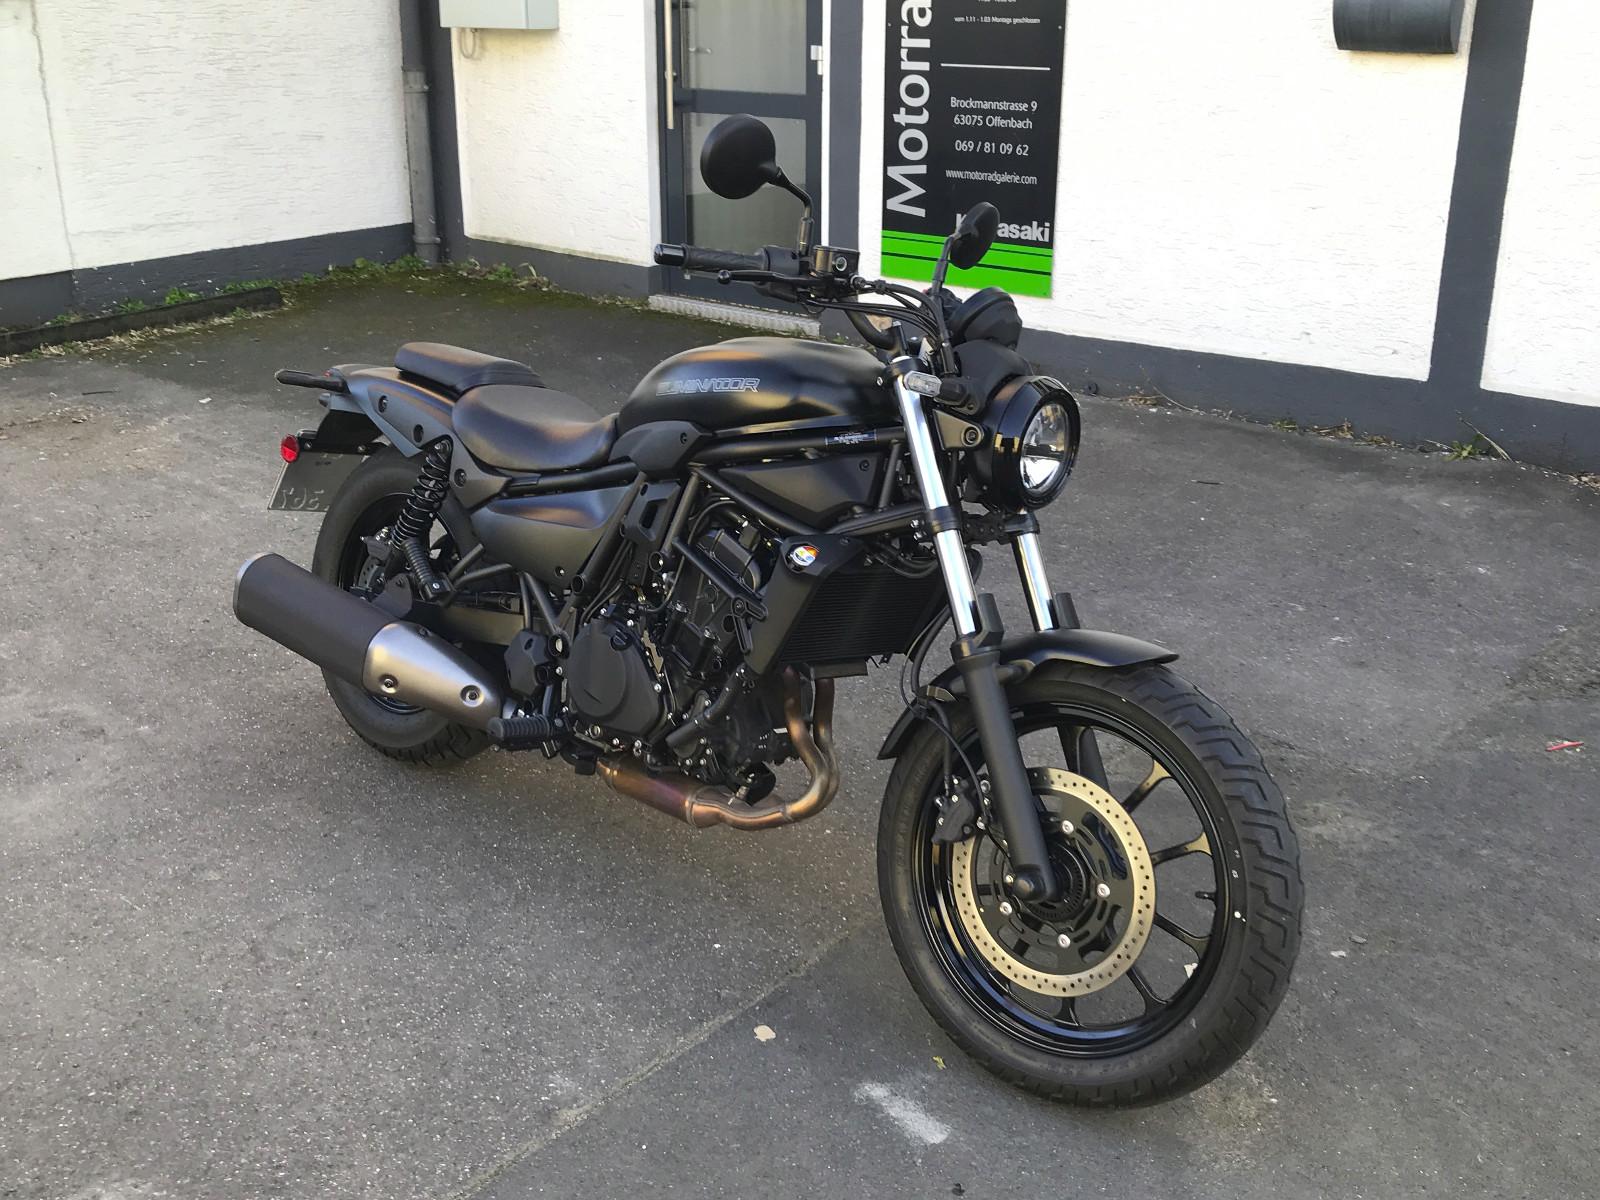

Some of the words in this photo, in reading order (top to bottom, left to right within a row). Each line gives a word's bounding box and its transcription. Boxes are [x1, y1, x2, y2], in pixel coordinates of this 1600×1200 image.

[950, 96, 1029, 113] Brockmannstrasse
[1030, 100, 1038, 112] 9
[953, 113, 984, 127] 63075
[985, 115, 1033, 129] Offenbach
[954, 140, 974, 153] 069
[976, 141, 982, 153] /
[983, 141, 996, 154] 81
[999, 142, 1013, 155] 09
[1015, 144, 1029, 156] 62
[945, 169, 1038, 185] www.motorradgalerie.com
